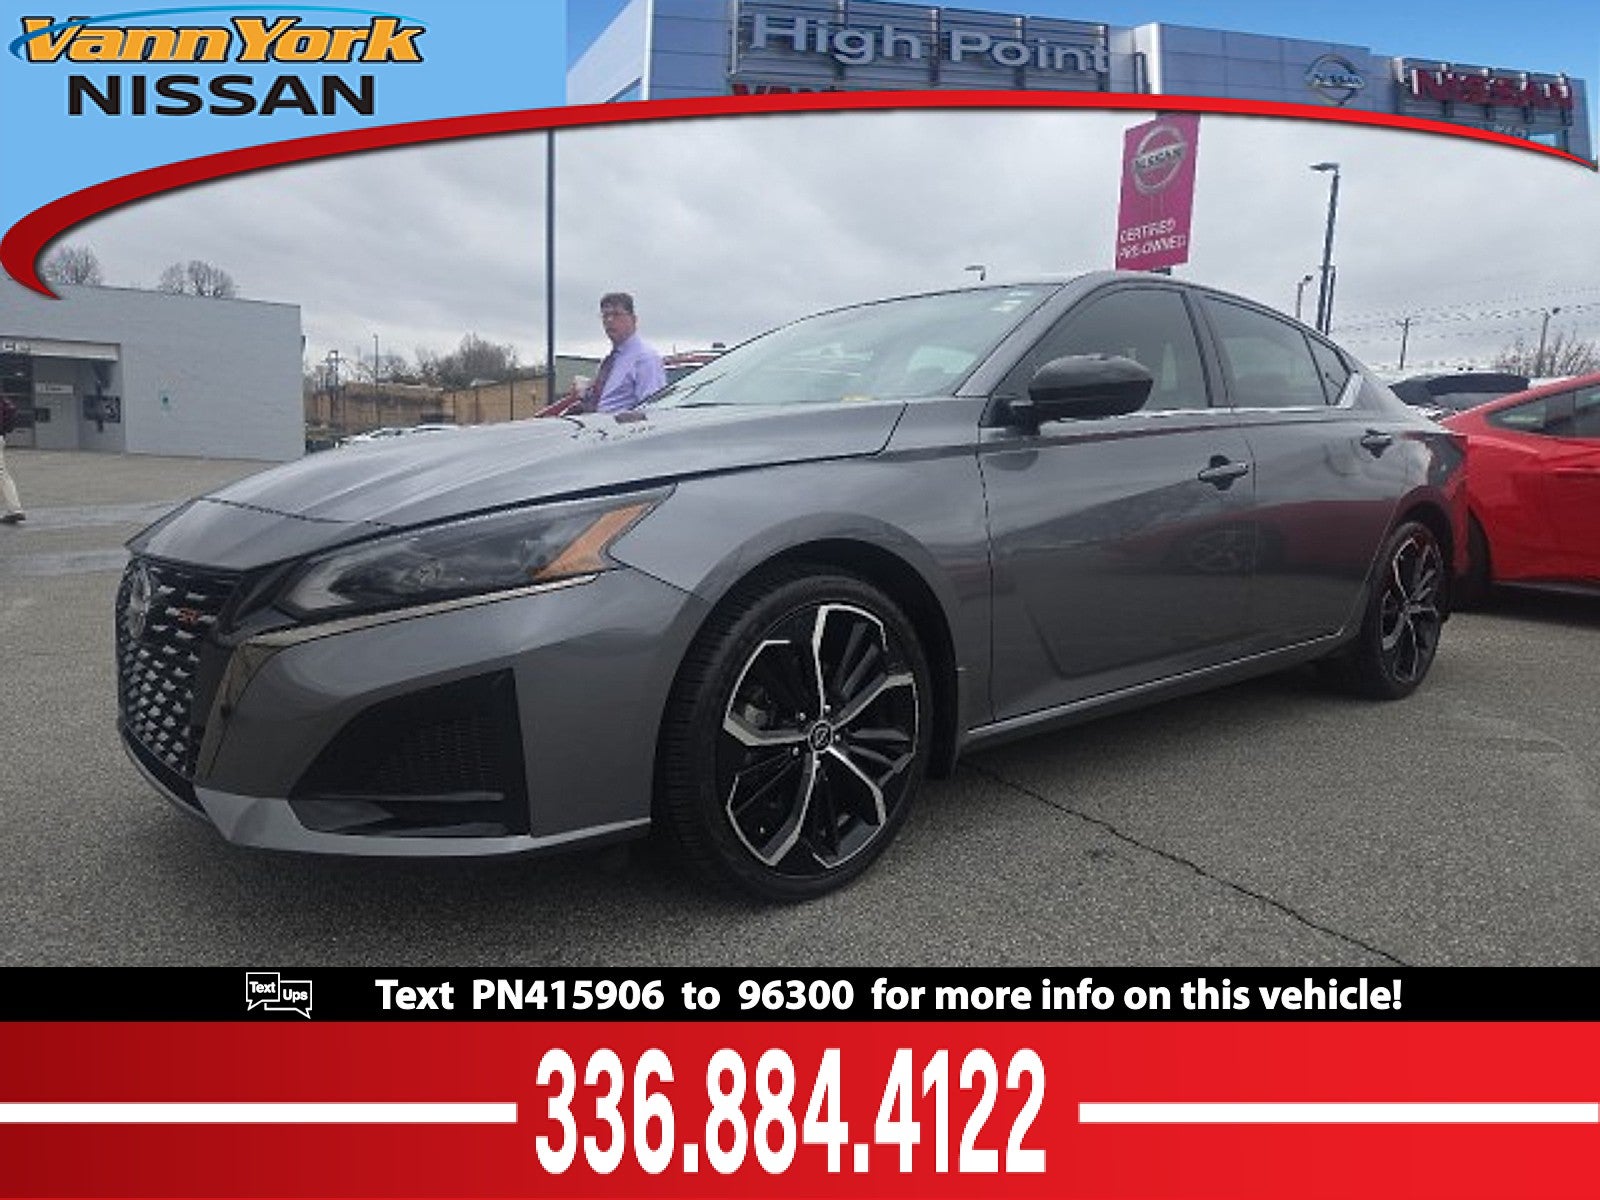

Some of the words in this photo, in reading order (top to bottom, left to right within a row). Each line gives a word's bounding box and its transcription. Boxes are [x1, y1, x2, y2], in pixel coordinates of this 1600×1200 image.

[750, 13, 922, 65] High
[947, 28, 1110, 74] Point
[1119, 217, 1176, 243] CERTIFIED
